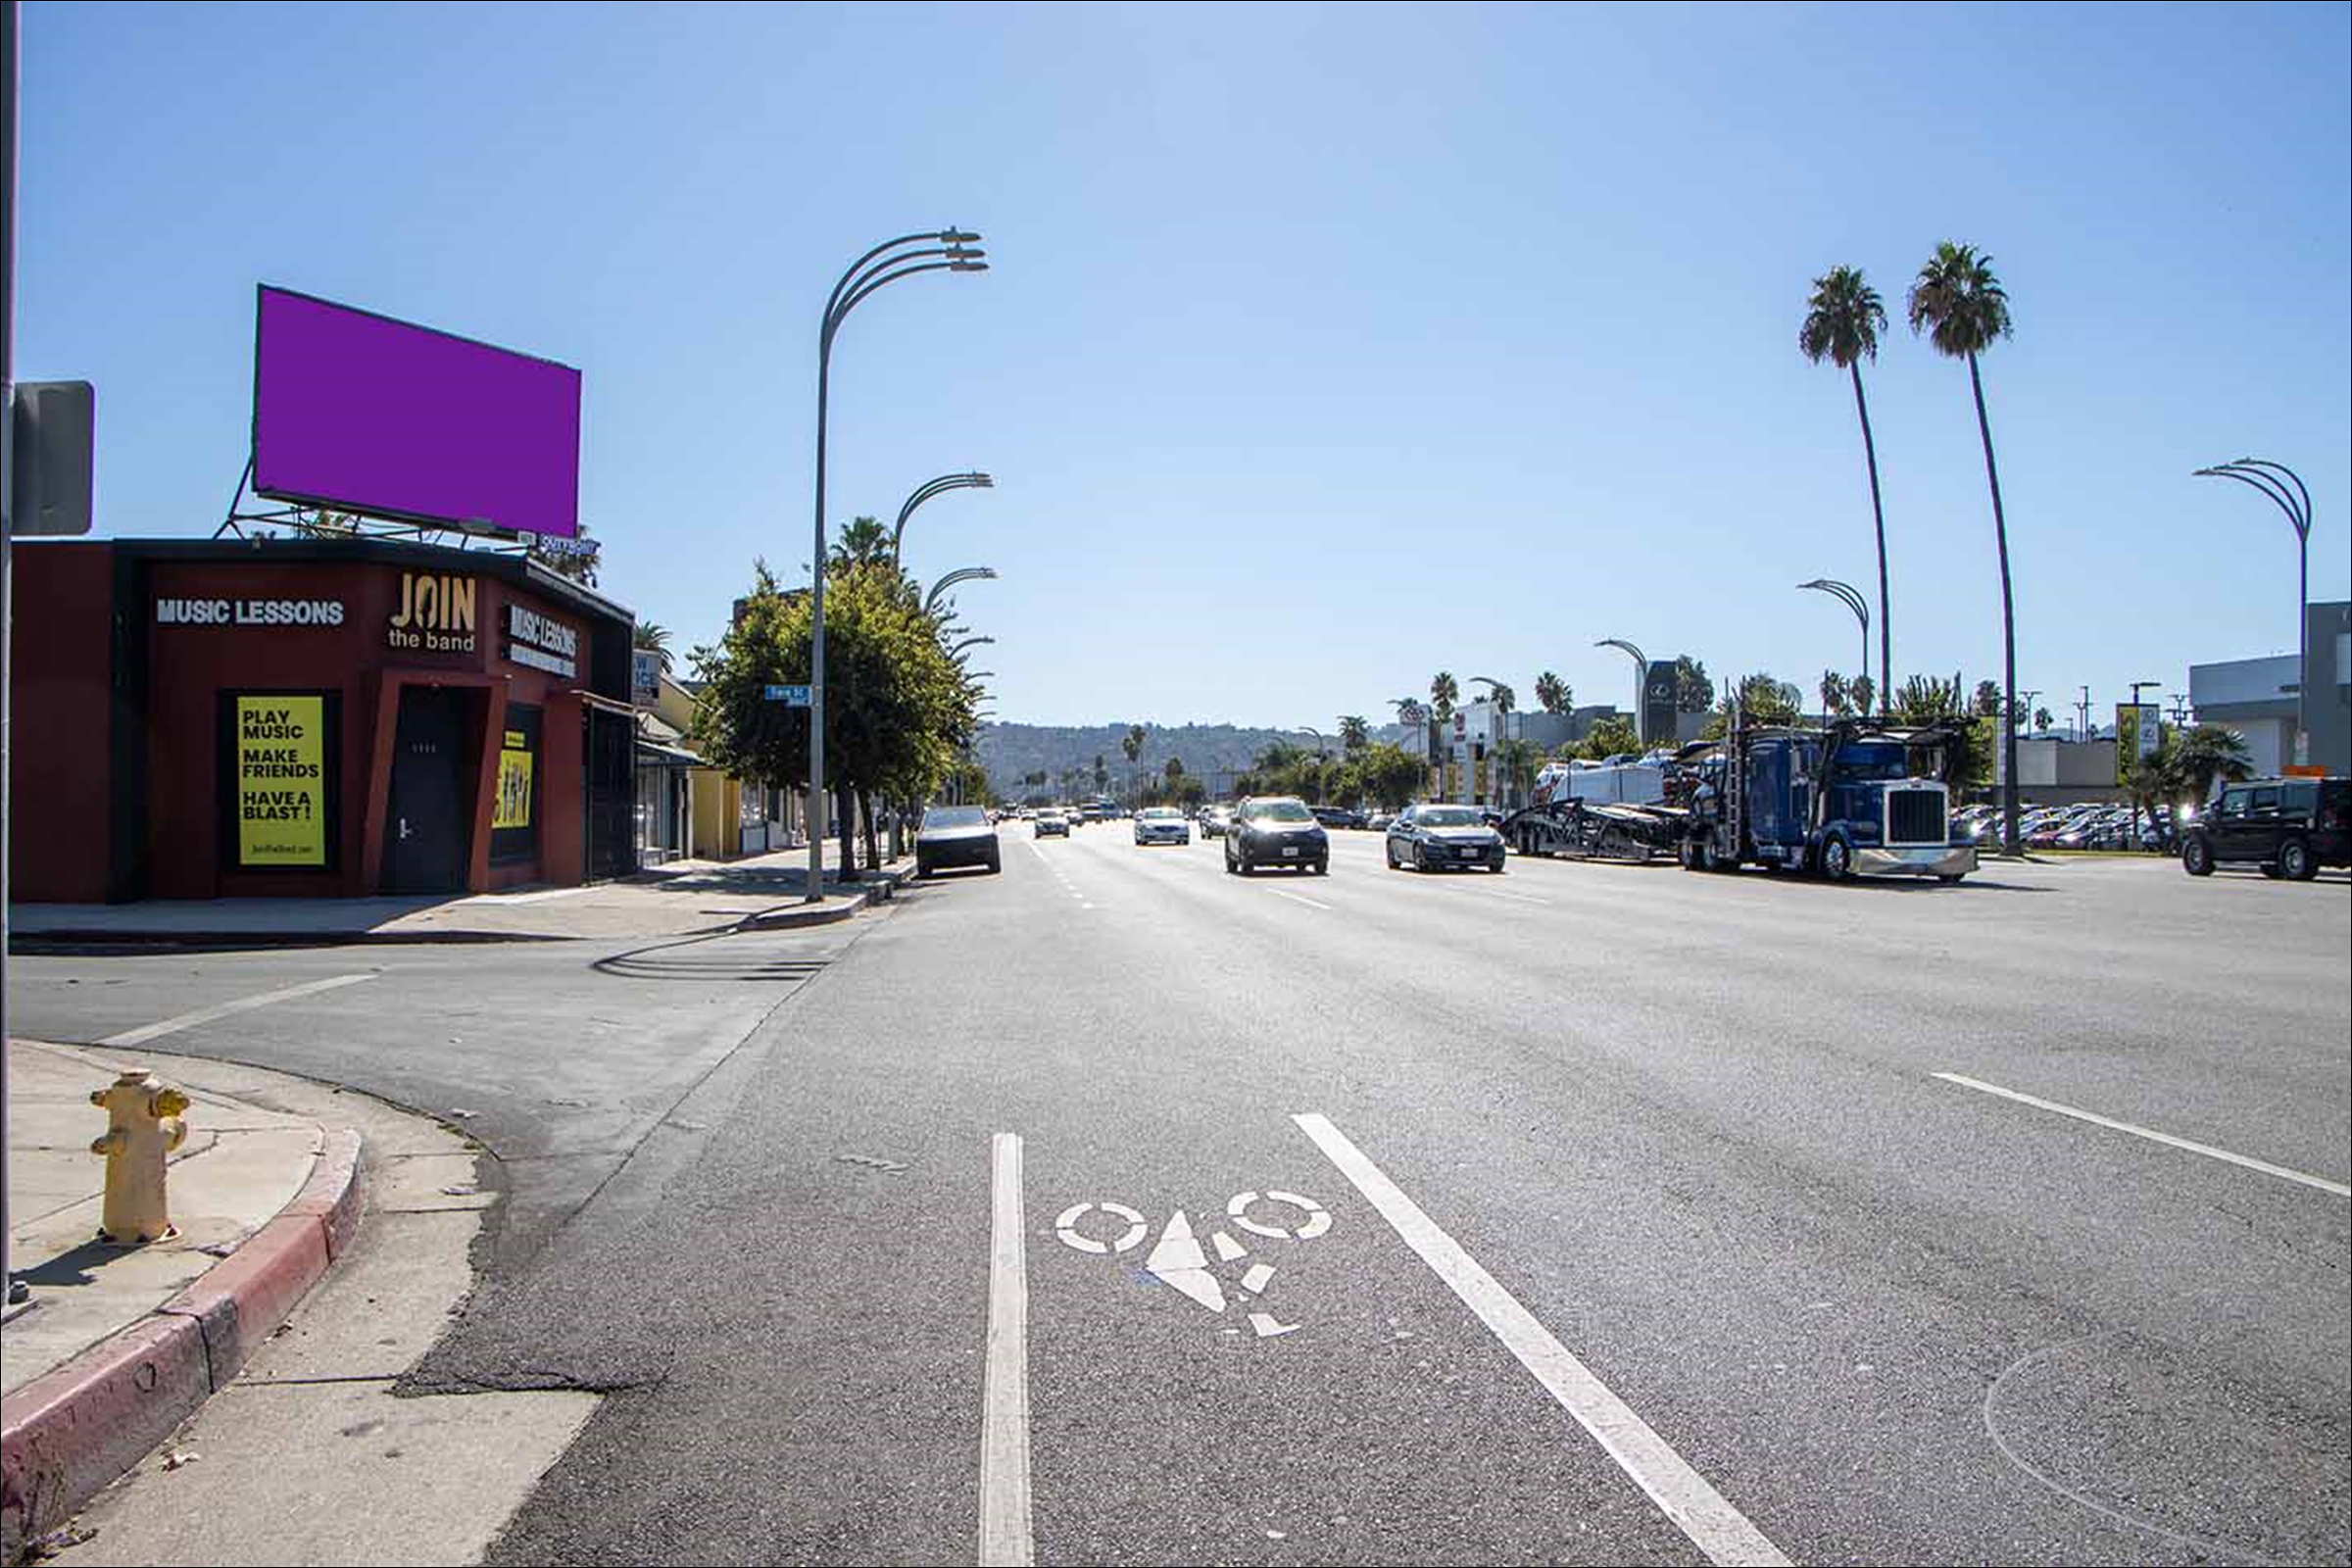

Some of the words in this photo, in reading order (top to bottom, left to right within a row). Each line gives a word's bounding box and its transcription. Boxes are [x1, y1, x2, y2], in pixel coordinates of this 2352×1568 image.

[390, 572, 475, 630] JOIN
[158, 600, 230, 623] MUSIC
[235, 601, 343, 624] LESSONS
[389, 629, 419, 647] the
[426, 631, 475, 652] band
[243, 710, 289, 724] PLAY
[244, 725, 304, 739] MUSIC
[244, 750, 298, 762] MAKE
[243, 764, 318, 778] FRIENDS
[243, 792, 294, 805] HAVE
[298, 792, 311, 805] A
